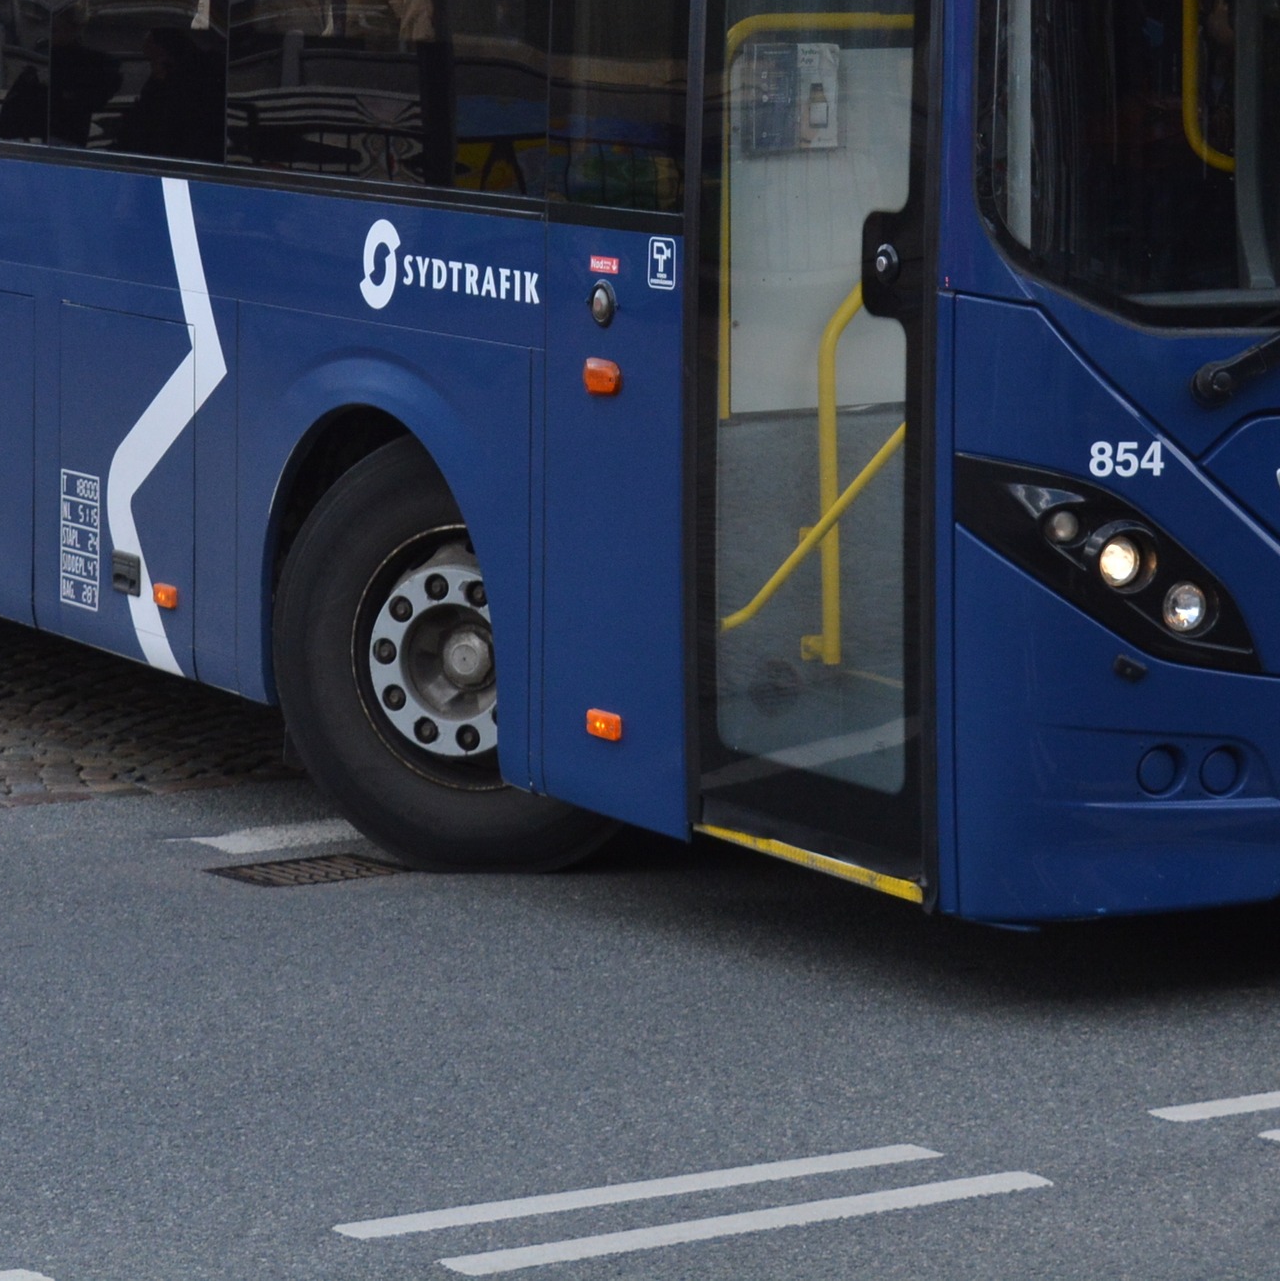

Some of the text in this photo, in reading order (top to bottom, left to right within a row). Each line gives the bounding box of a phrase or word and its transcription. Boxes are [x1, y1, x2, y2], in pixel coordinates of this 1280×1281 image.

[403, 254, 540, 304] SYDTRAFIK
[1089, 441, 1165, 477] 854
[76, 478, 98, 501] 18000
[62, 501, 98, 526] NL 5115
